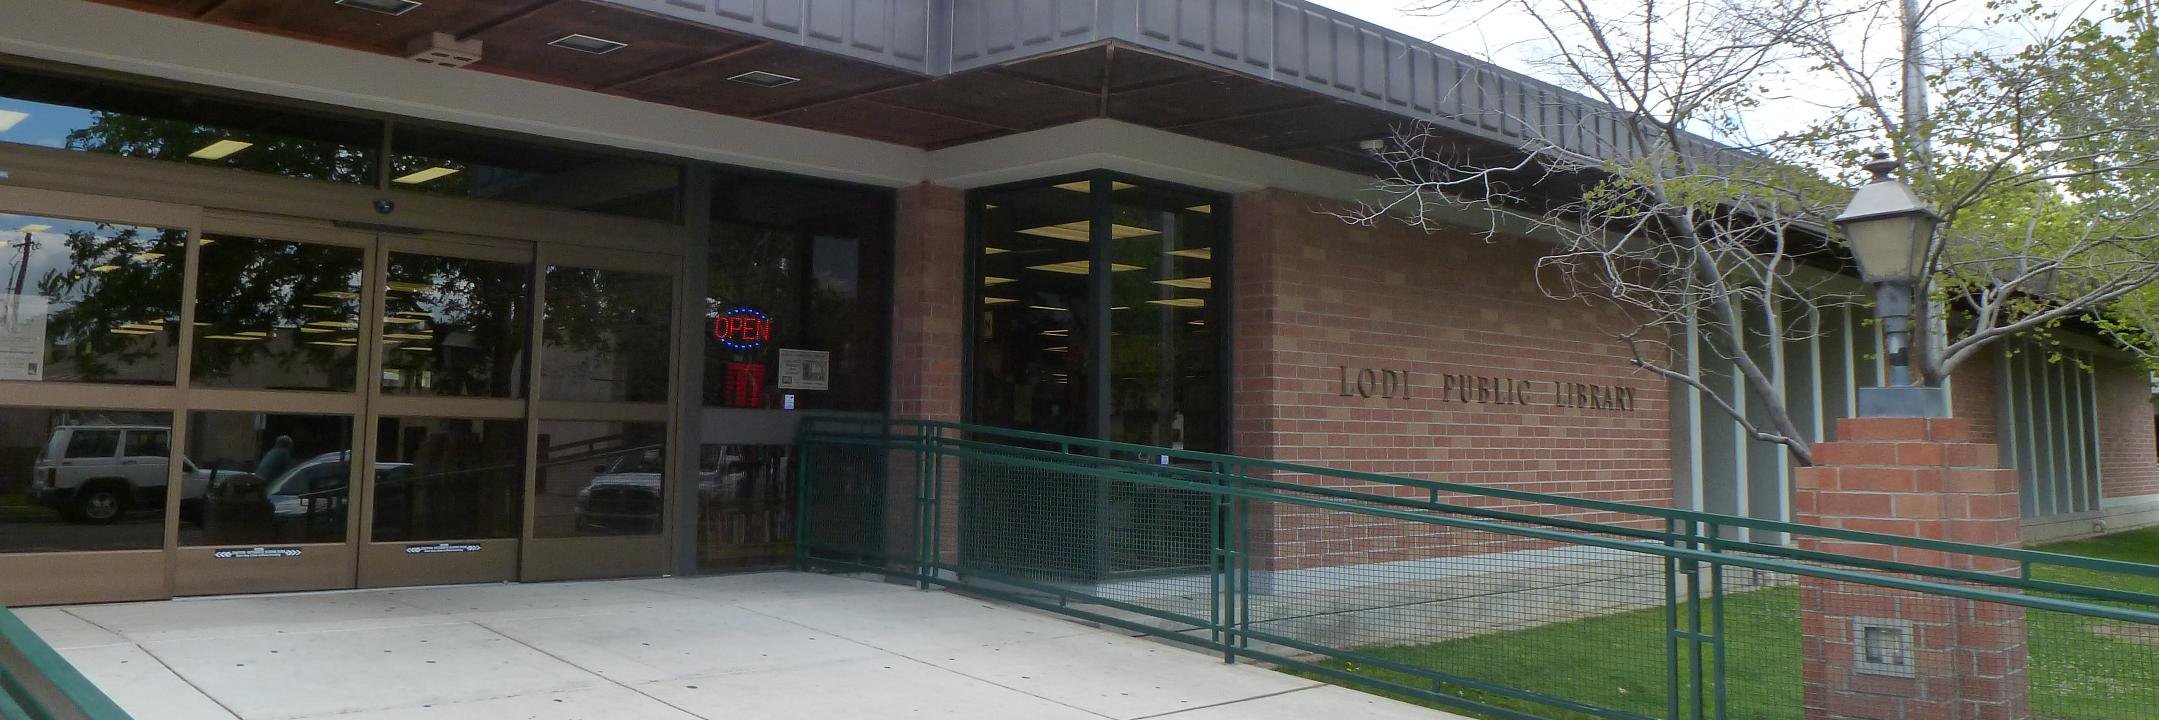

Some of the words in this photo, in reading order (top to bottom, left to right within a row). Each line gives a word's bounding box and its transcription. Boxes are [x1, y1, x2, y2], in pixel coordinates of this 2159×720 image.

[714, 316, 770, 340] OPEN
[1339, 365, 1410, 399] LODI
[1443, 373, 1530, 405] PUBLIC
[1554, 381, 1636, 411] LIBRARY
